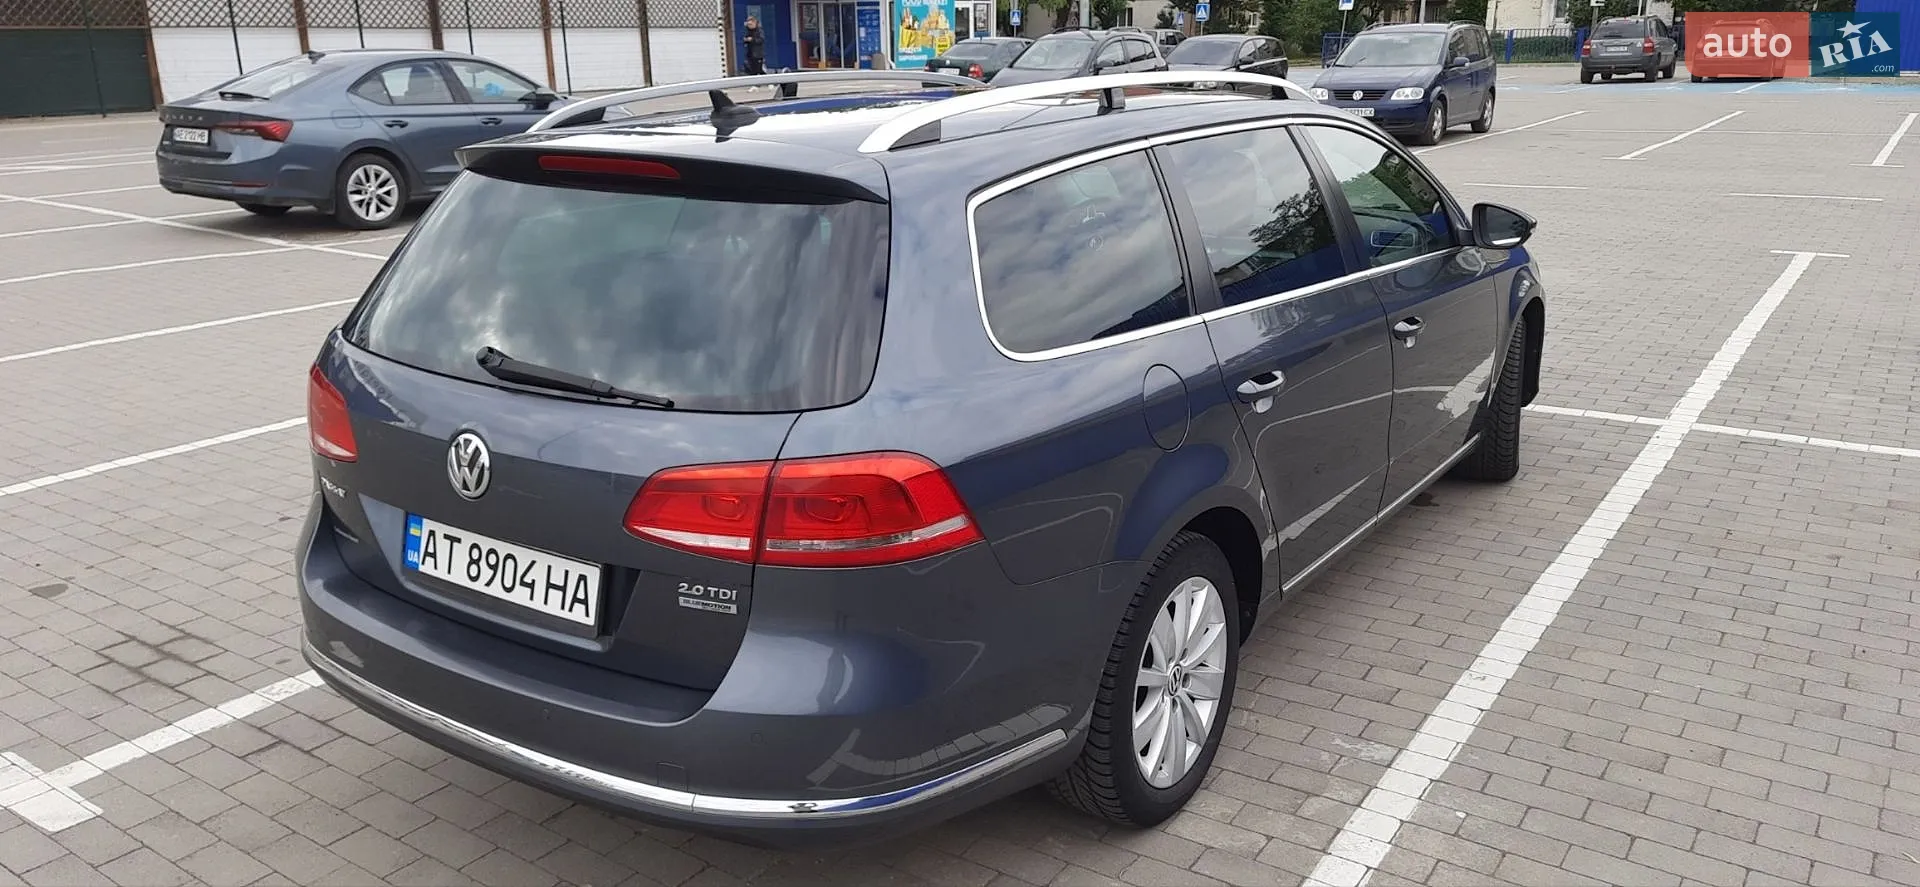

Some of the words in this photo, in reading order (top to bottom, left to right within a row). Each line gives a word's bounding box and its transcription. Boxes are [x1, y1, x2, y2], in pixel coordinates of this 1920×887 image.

[407, 551, 419, 563] UA
[421, 529, 462, 575] AT
[466, 542, 537, 601] 8904
[544, 564, 590, 617] HA
[707, 586, 738, 601] TDI
